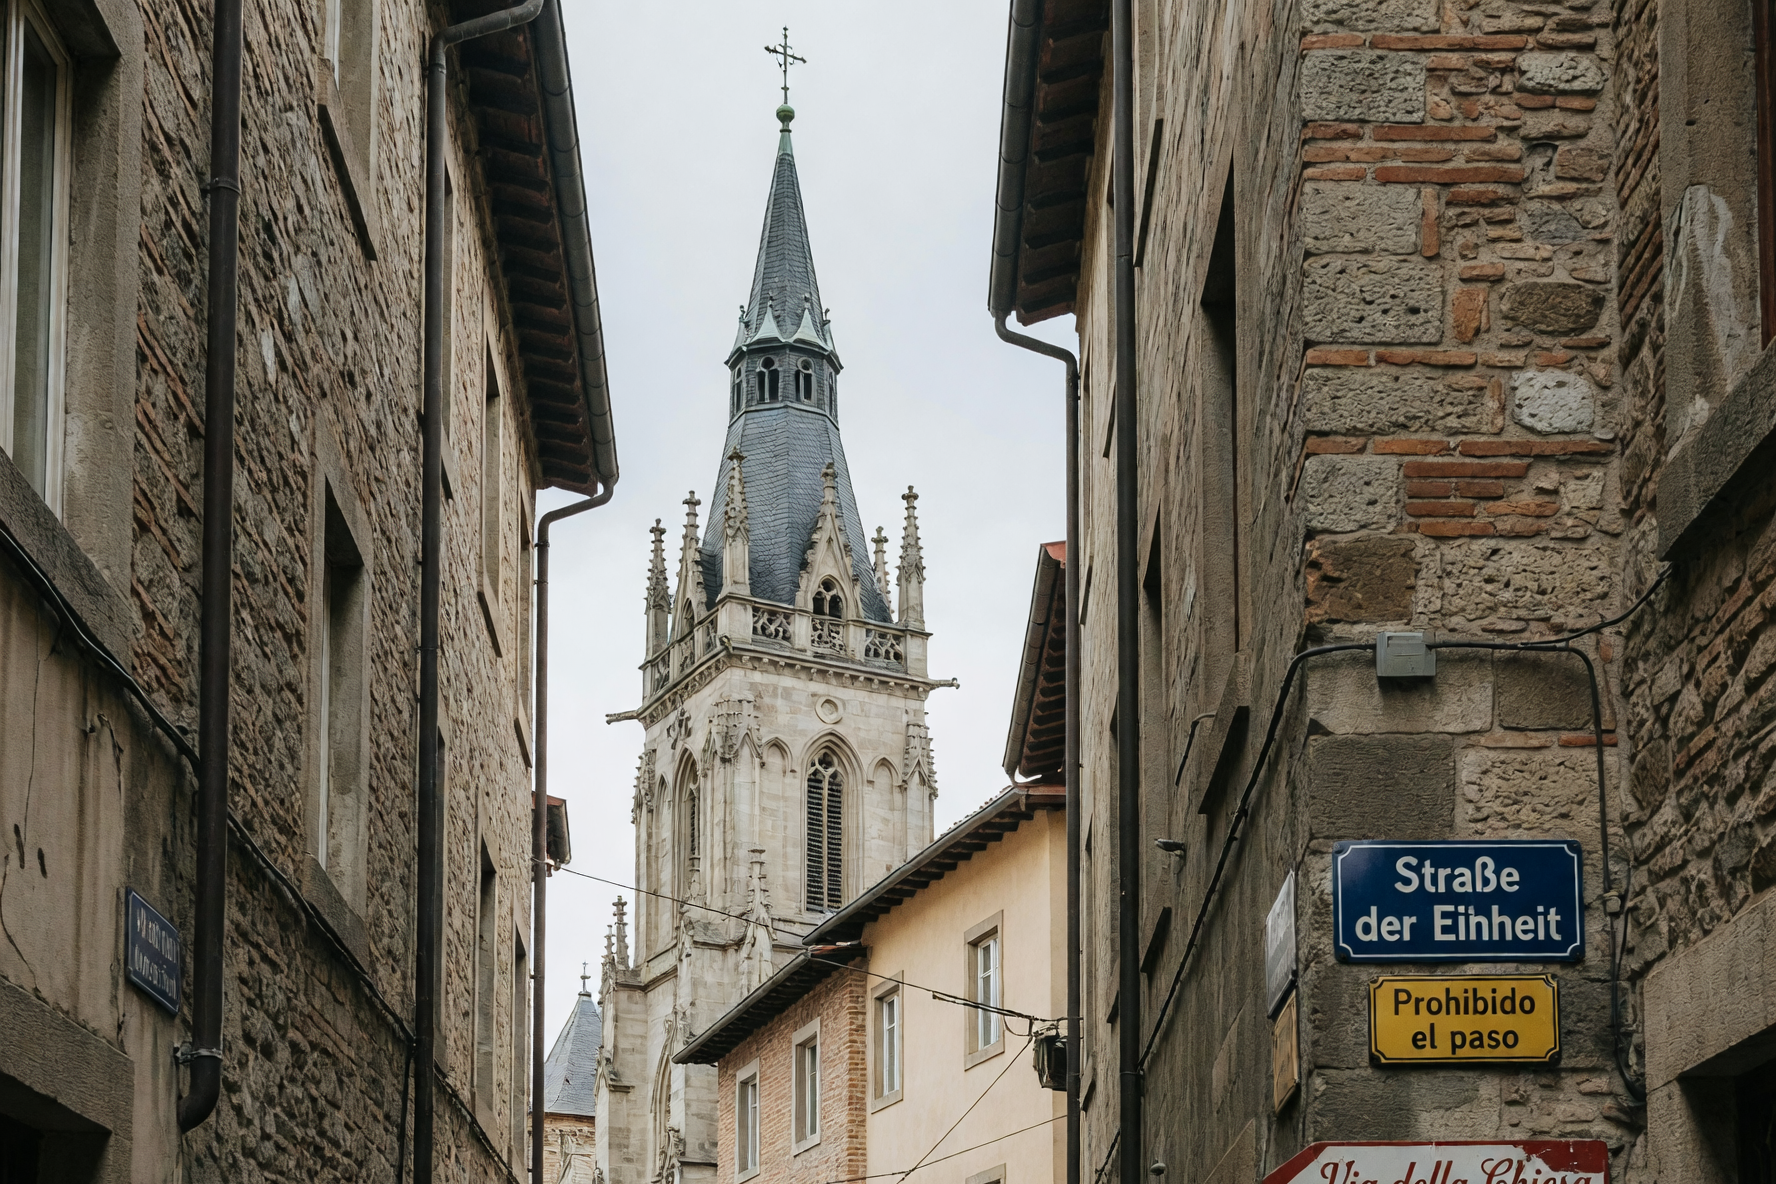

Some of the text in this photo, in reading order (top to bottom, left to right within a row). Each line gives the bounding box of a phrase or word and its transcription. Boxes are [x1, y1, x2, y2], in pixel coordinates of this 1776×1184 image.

[1394, 855, 1520, 893] Straße
[1355, 904, 1562, 942] der Einheit
[1393, 986, 1536, 1016] Prohibido
[1411, 1022, 1520, 1056] el paso
